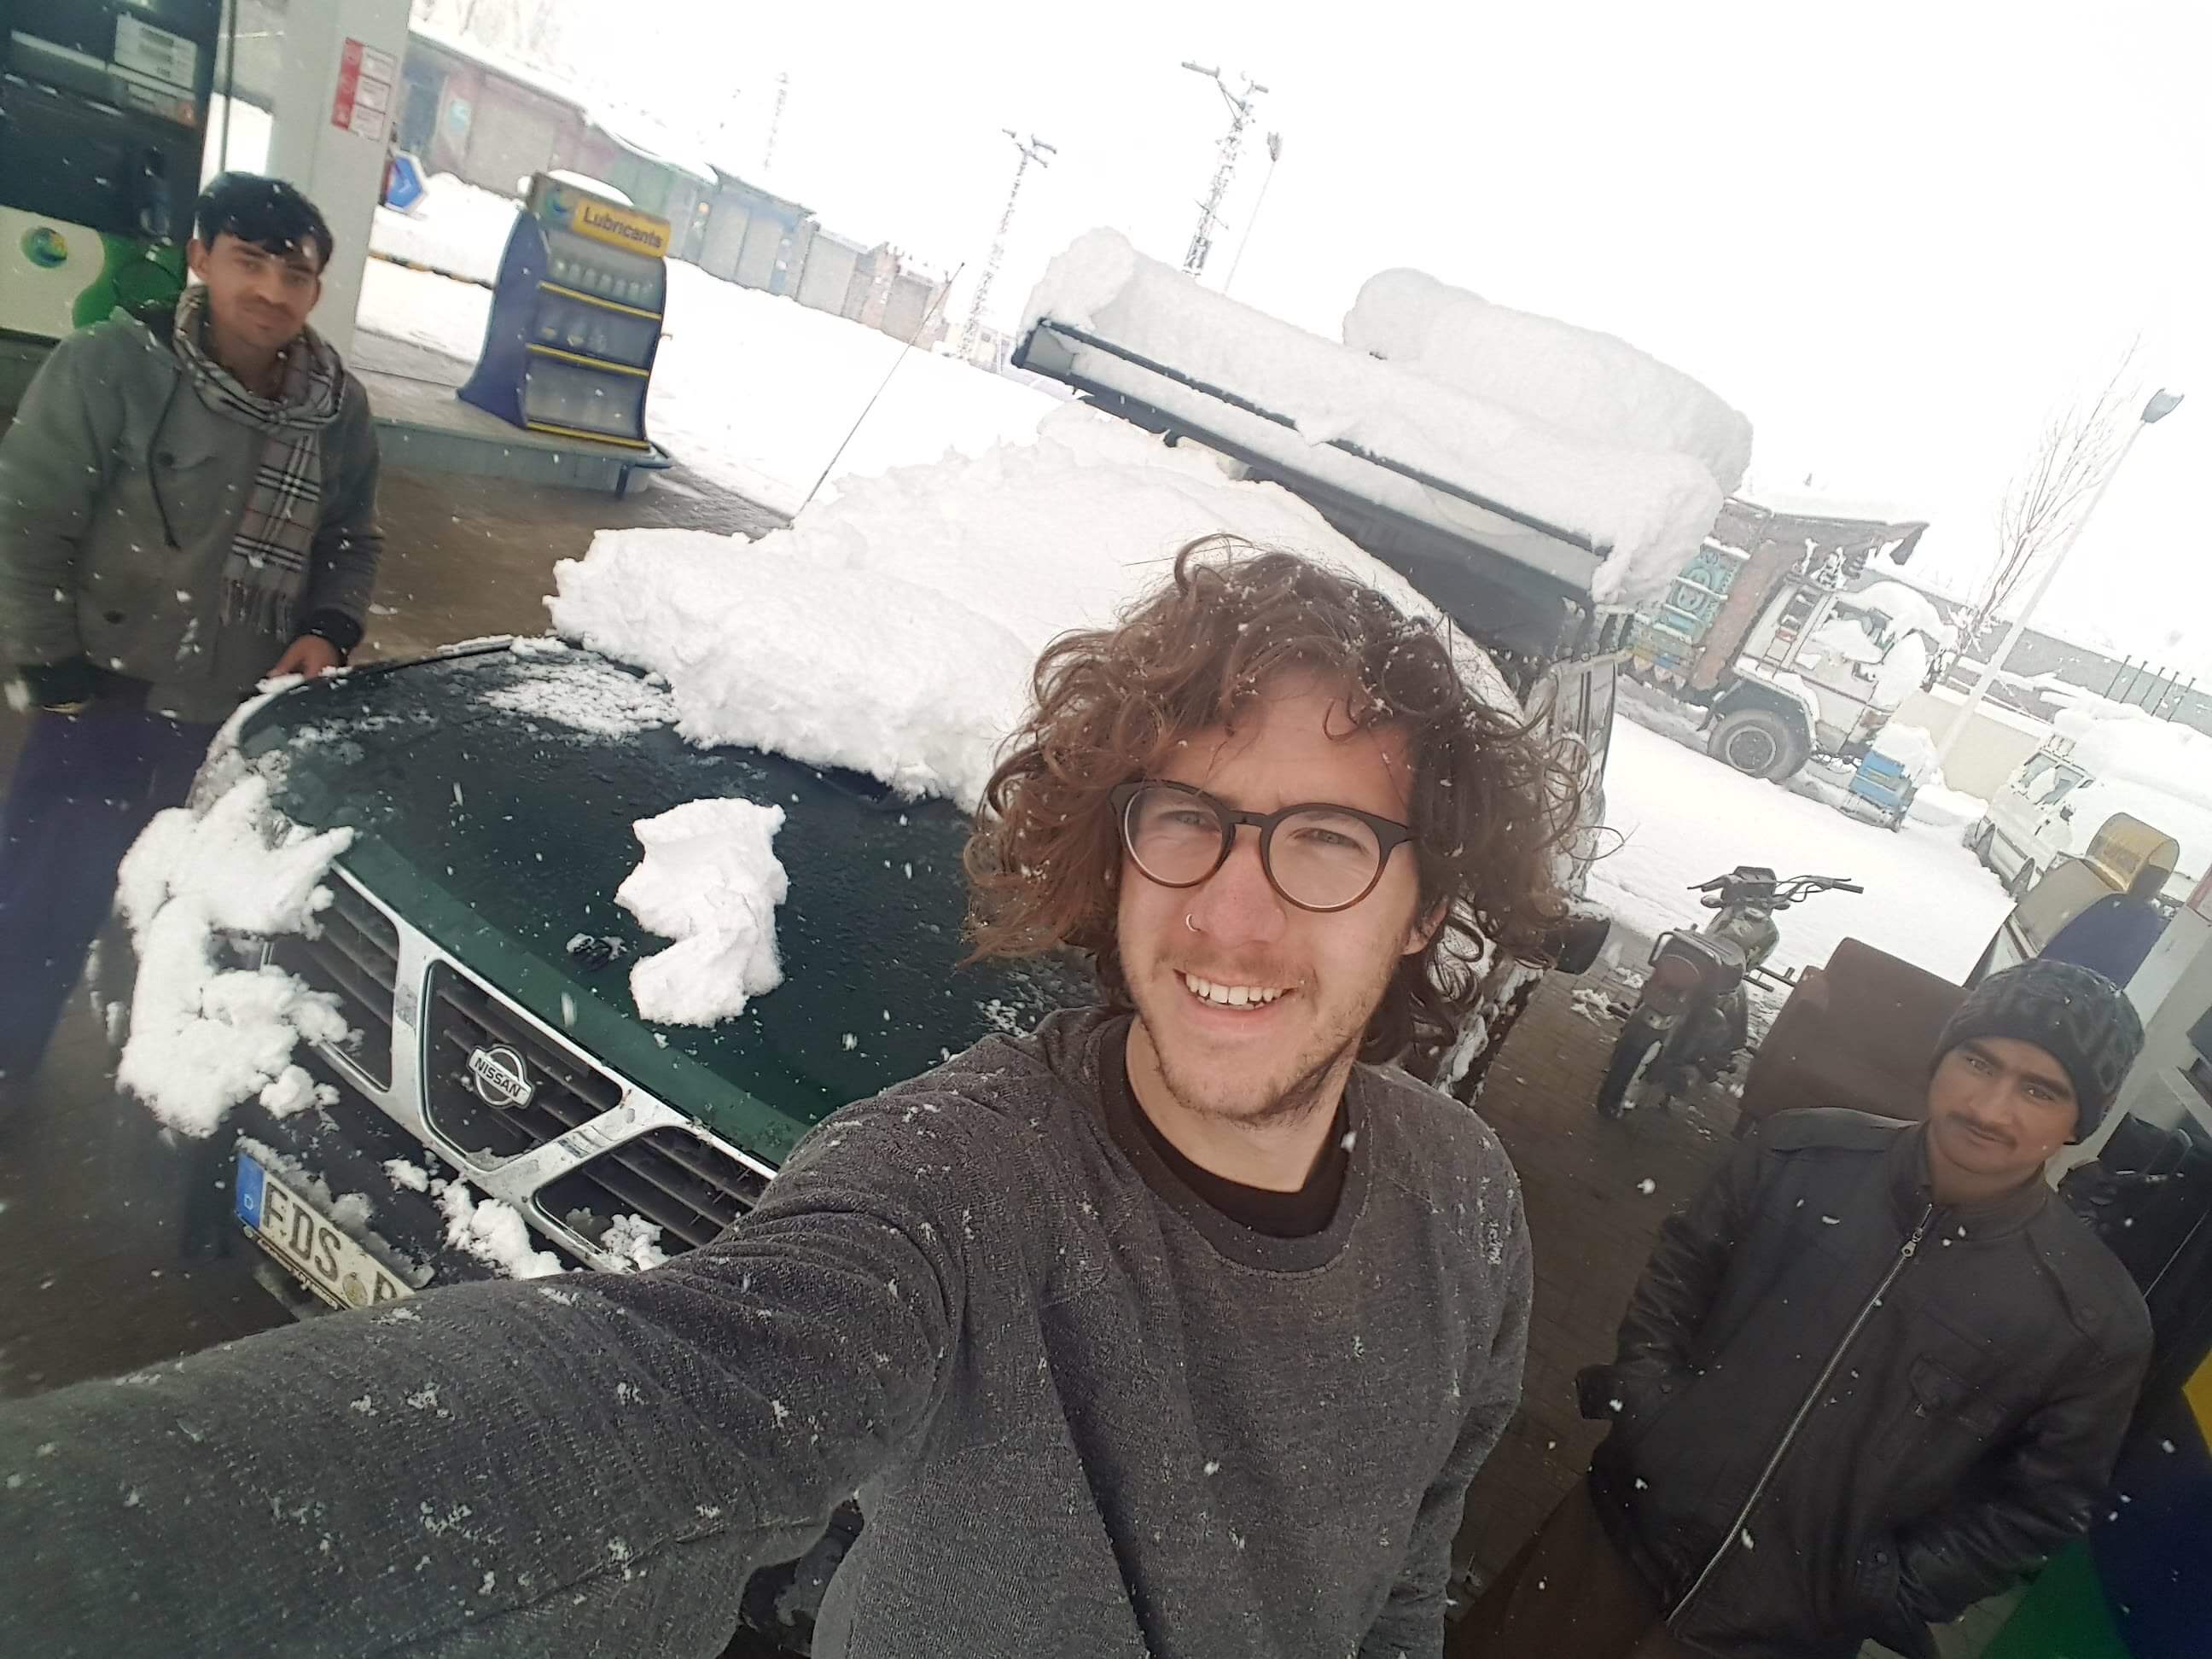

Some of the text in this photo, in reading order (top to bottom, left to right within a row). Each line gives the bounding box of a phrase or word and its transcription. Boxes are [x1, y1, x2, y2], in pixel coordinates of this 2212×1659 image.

[583, 207, 663, 248] Lubricants
[474, 1057, 521, 1097] NISSAN
[244, 1194, 254, 1210] D
